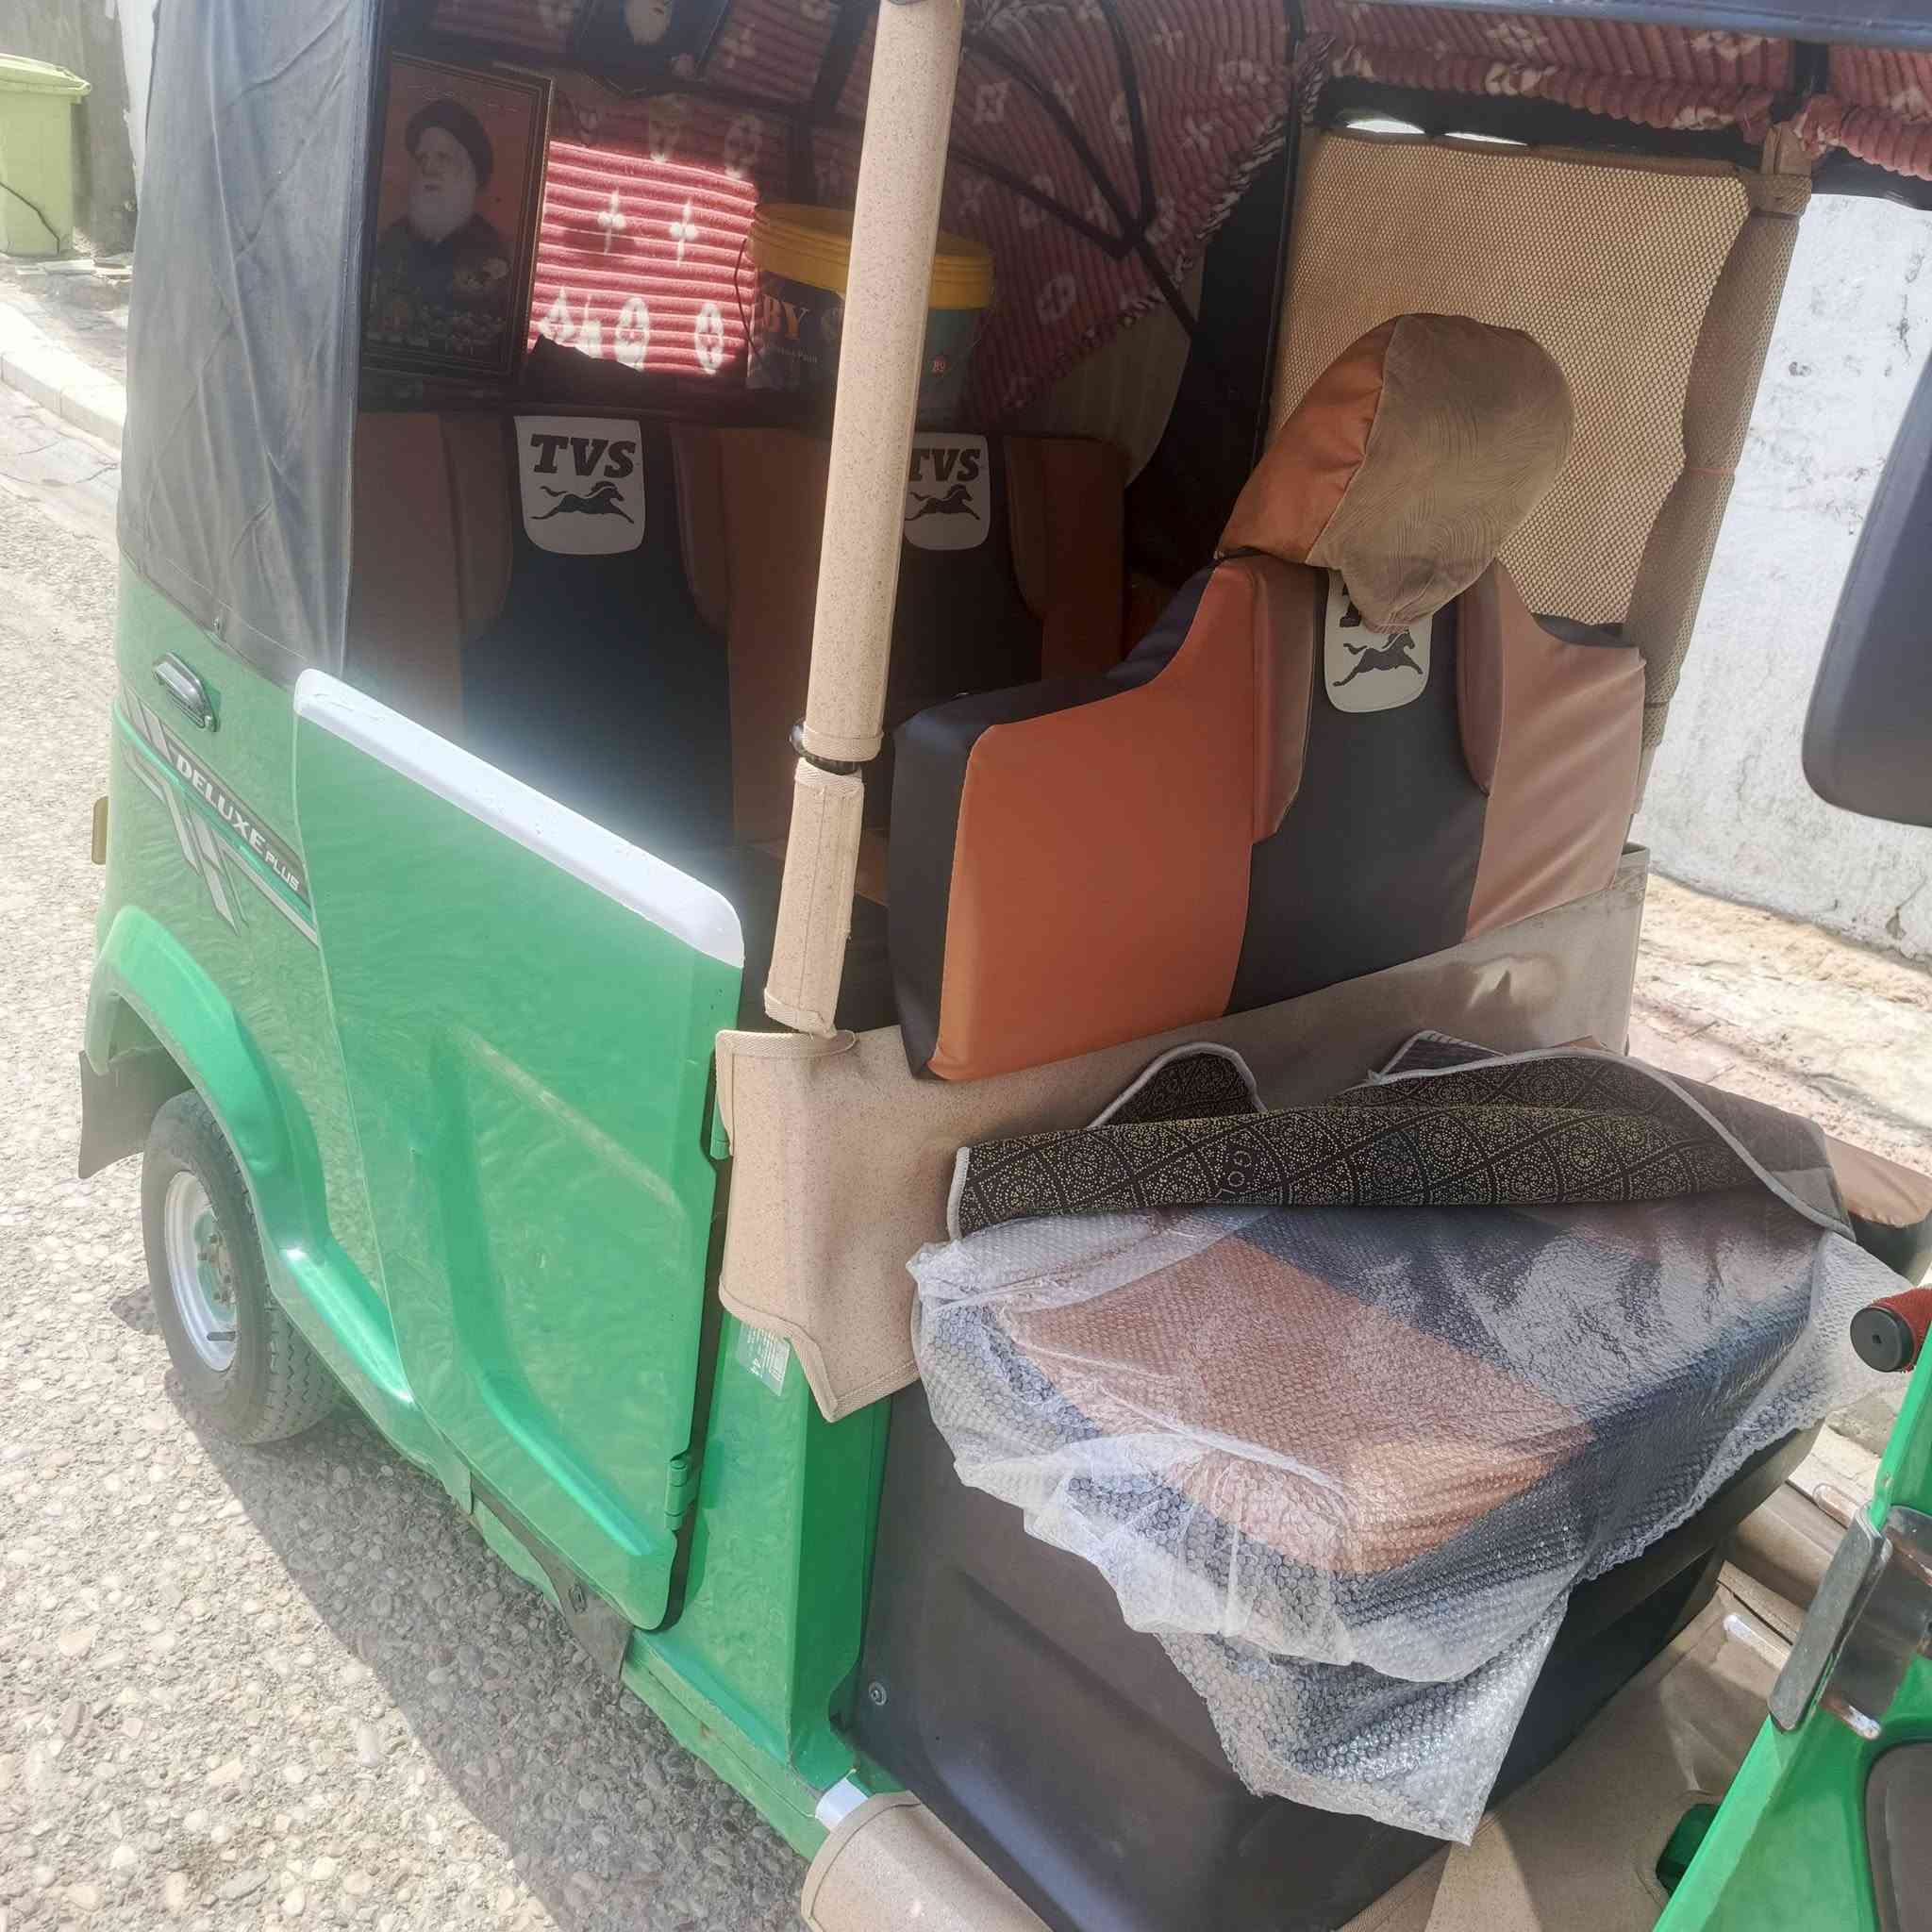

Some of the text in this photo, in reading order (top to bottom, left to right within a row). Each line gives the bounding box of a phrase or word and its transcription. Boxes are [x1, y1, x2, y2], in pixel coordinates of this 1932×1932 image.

[530, 434, 637, 478] TVS
[175, 755, 301, 891] DELUXE PLUS
